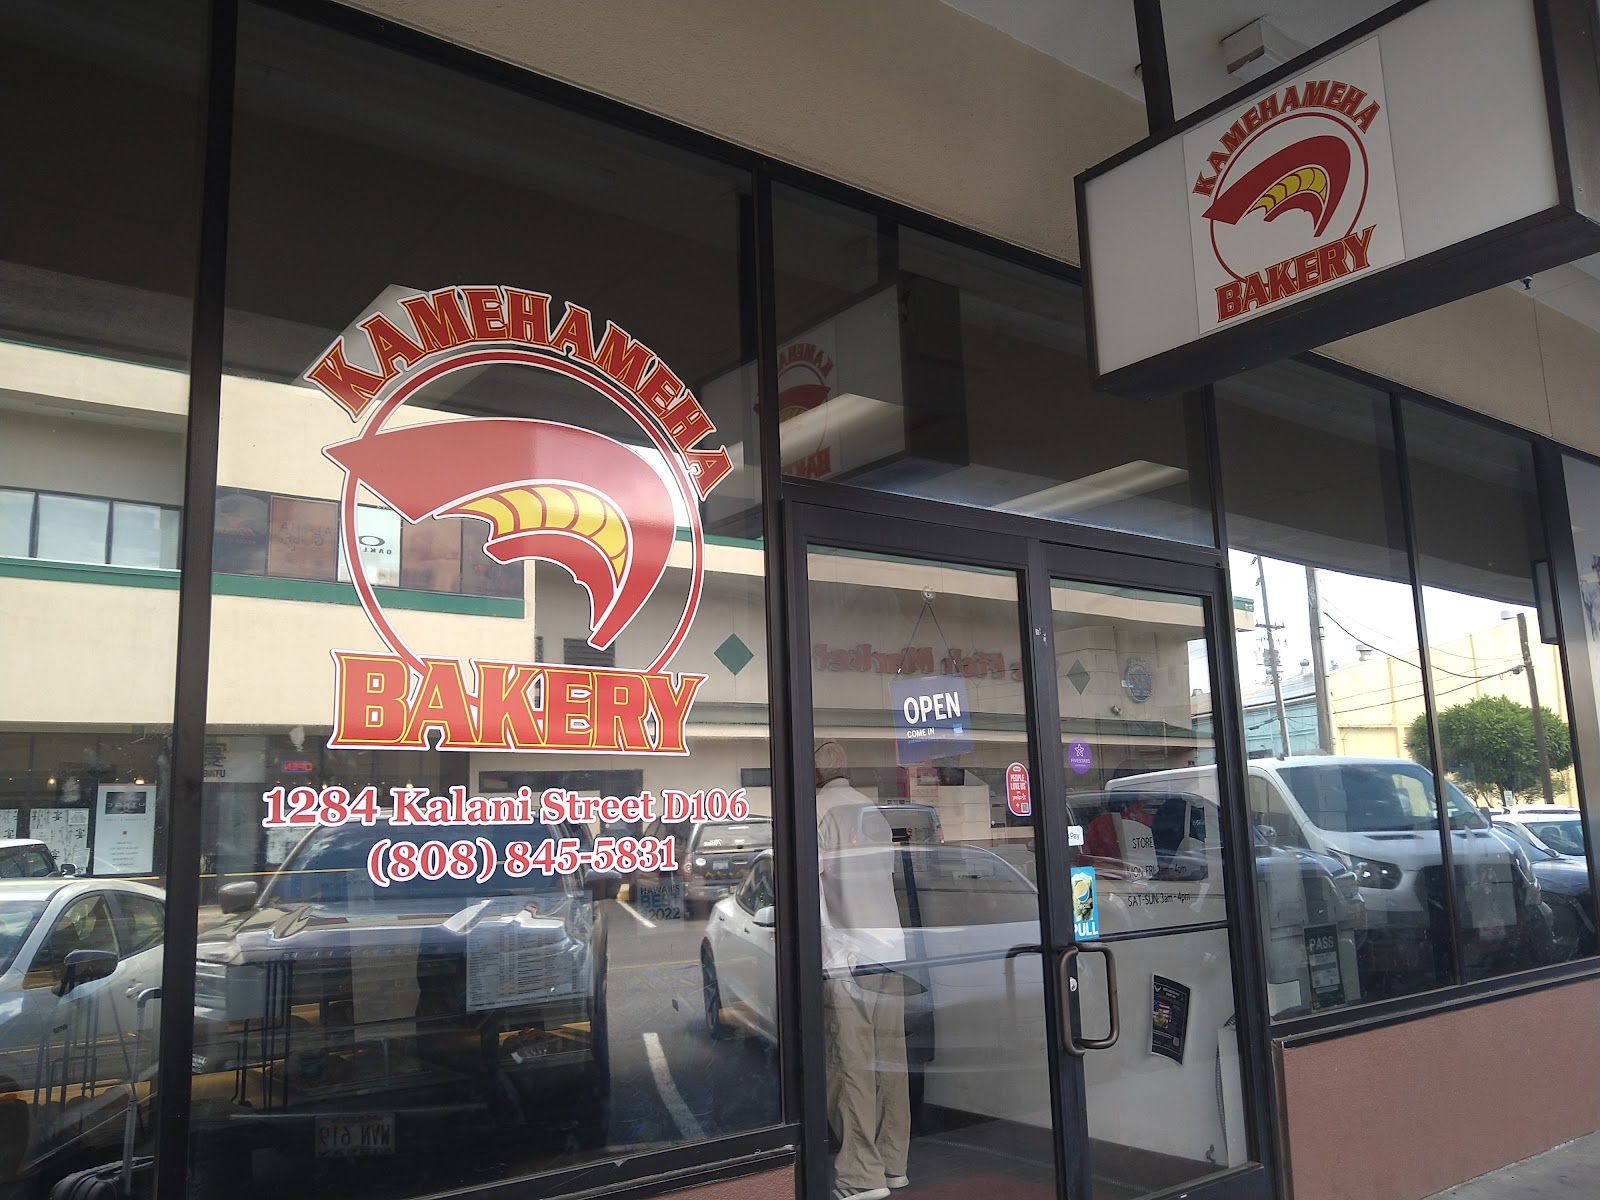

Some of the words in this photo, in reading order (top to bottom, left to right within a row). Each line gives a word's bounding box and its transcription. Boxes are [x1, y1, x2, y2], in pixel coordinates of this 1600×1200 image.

[1192, 80, 1380, 197] KAMEHAMEHA
[1214, 224, 1377, 323] BAKERY
[303, 285, 734, 502] KAMEHAMEHA
[328, 649, 709, 757] BAKERY
[903, 692, 961, 724] OPEN
[907, 728, 927, 738] COME
[928, 728, 935, 736] IN
[1010, 774, 1025, 782] PEOPLE
[262, 786, 380, 828] 1284
[389, 787, 533, 827] Kalani
[539, 788, 654, 825] Street
[661, 788, 750, 824] D106
[1070, 832, 1080, 840] Pay
[1132, 837, 1154, 849] STORE
[367, 837, 497, 887] (808)
[505, 836, 678, 878] 845-5831
[640, 893, 681, 909] BEST
[648, 906, 681, 920] 2022
[1309, 936, 1334, 952] PASS
